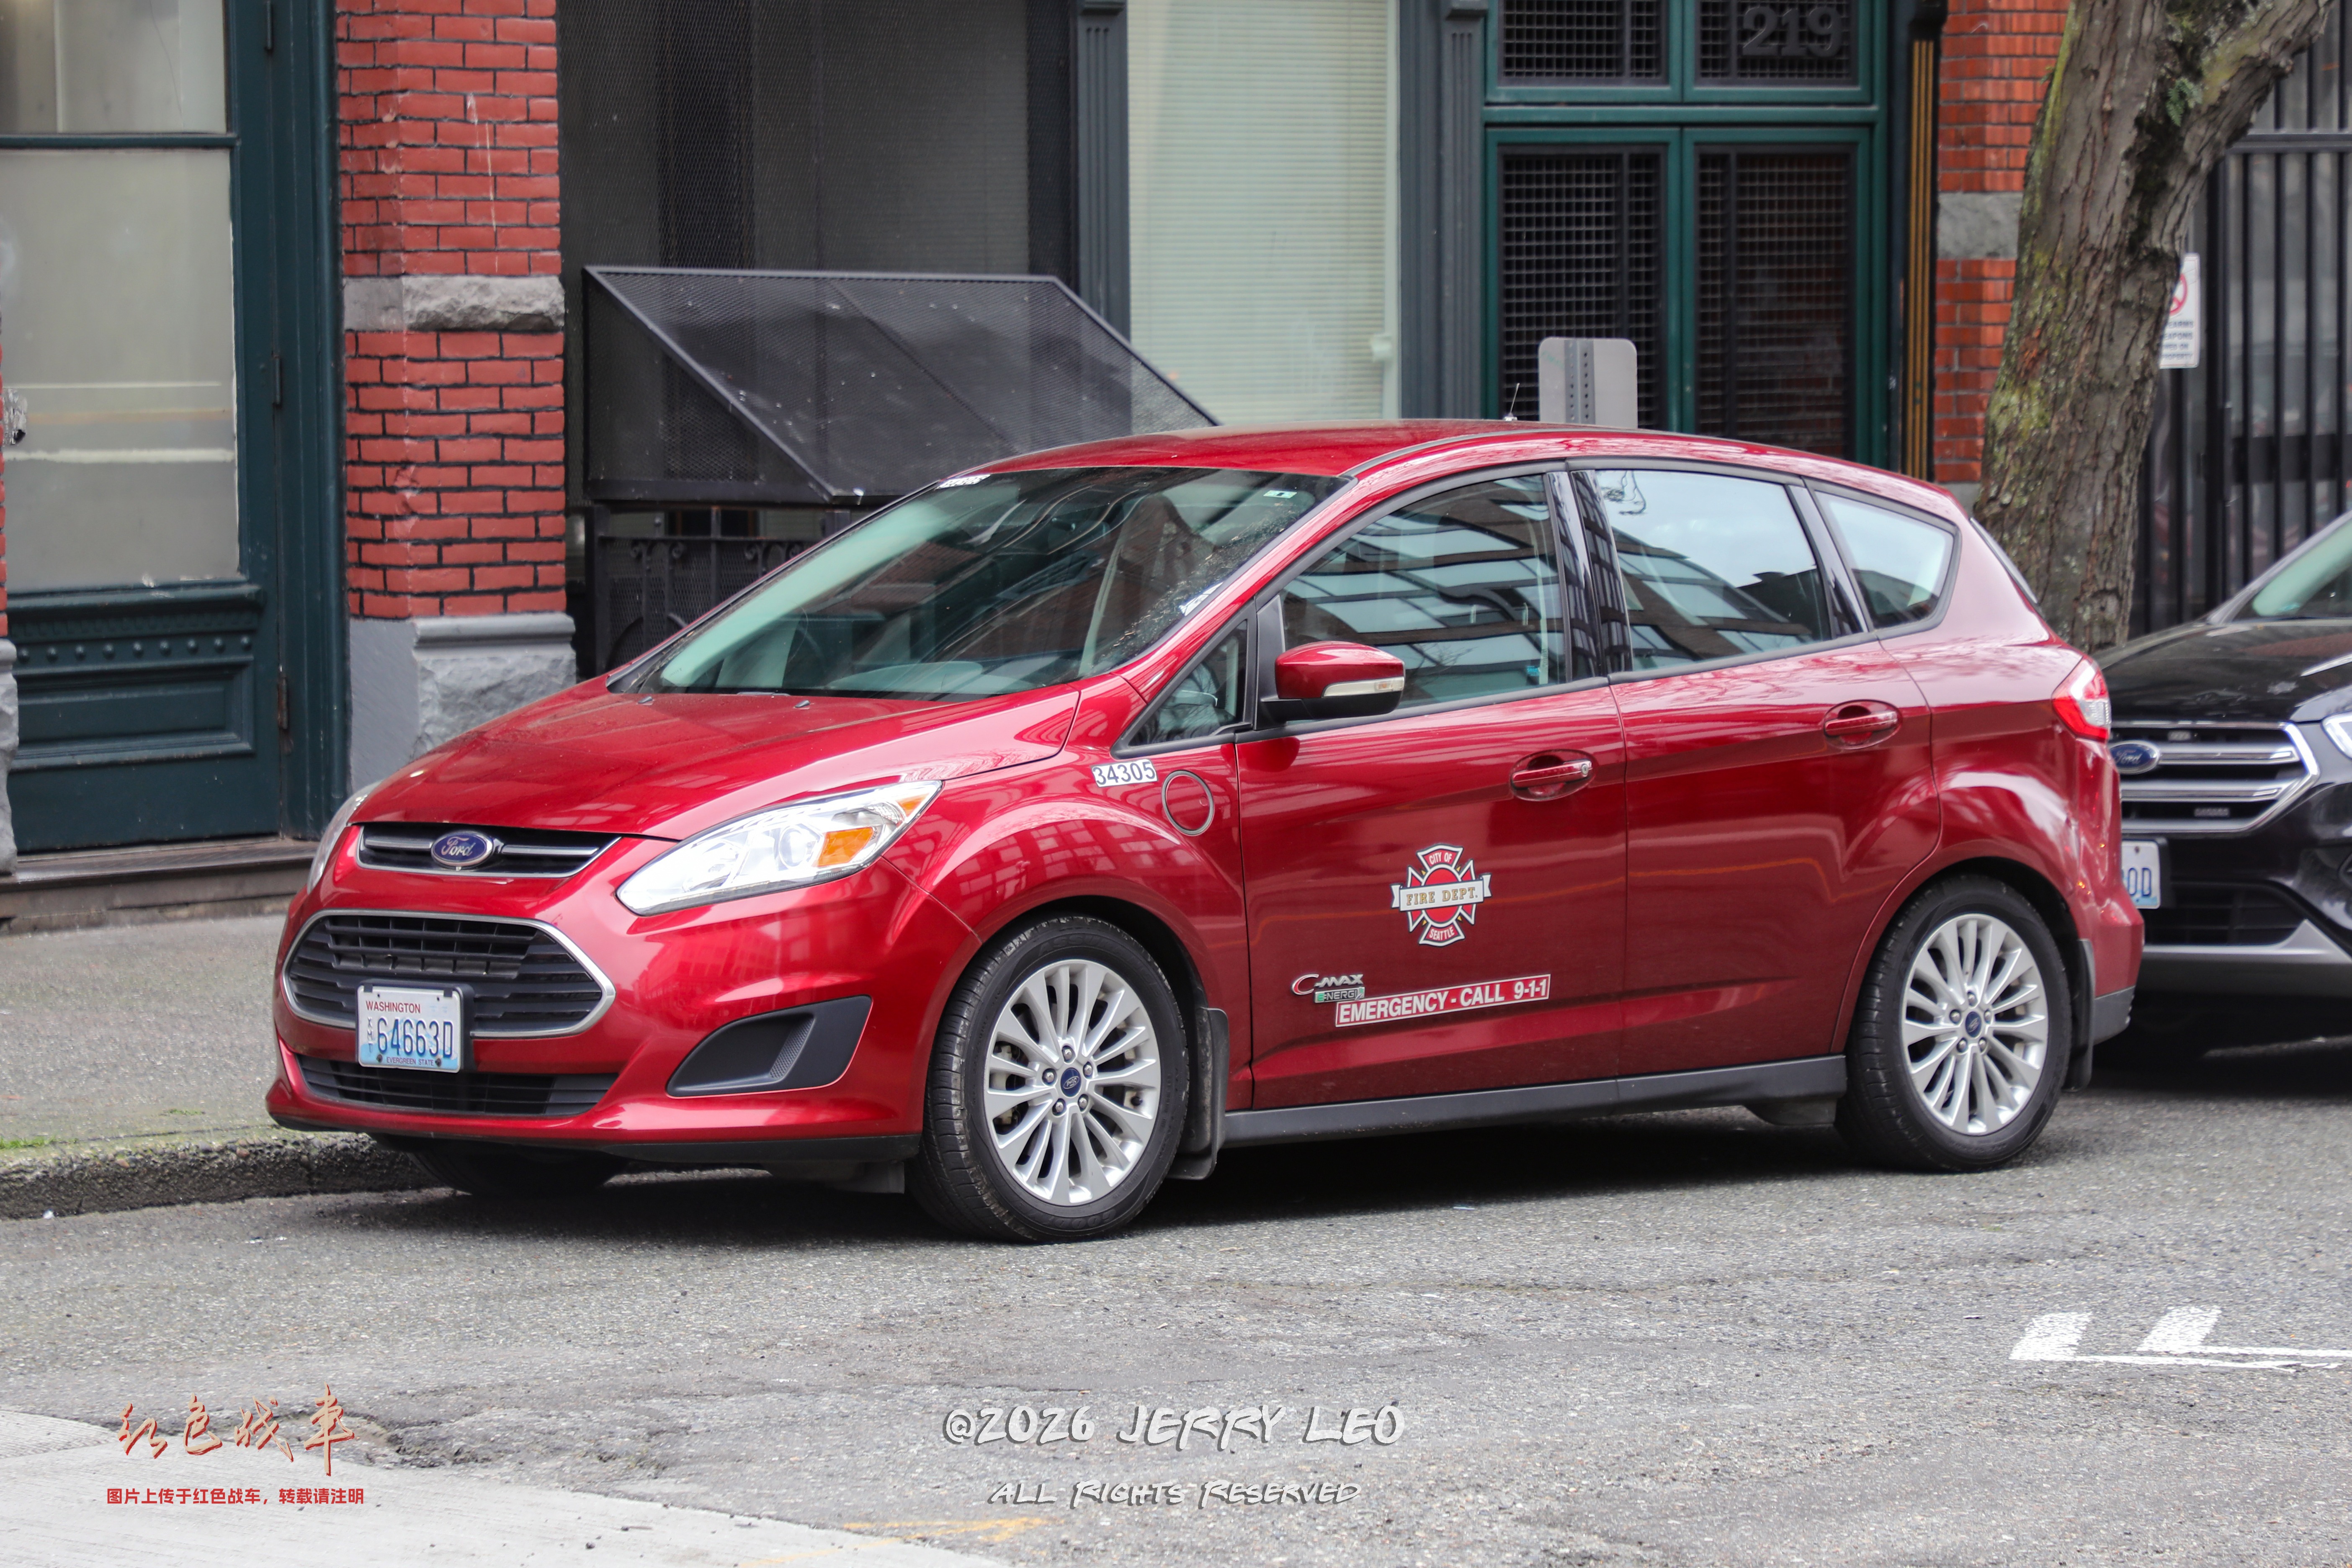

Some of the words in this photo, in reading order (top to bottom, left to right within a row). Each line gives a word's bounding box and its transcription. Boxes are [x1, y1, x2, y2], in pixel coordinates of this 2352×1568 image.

[1742, 6, 1842, 57] 219
[2115, 749, 2143, 765] Ford
[1093, 761, 1155, 785] 34305
[441, 836, 476, 856] Ford
[1429, 852, 1442, 865] CITY
[1444, 852, 1453, 863] OF
[2121, 867, 2151, 897] 0D
[1406, 891, 1435, 906] FIRE
[1442, 886, 1479, 902] DEPT.
[1429, 926, 1455, 941] SEATTLE
[1317, 990, 1358, 1002] ENERGI
[1339, 991, 1449, 1023] EMERGENCY
[1460, 984, 1505, 1007] CALL
[1514, 978, 1548, 1000] 9-1-1
[366, 1000, 421, 1014] WASHINGTON
[377, 1017, 453, 1059] 64663D
[386, 1057, 416, 1065] EVERGREEN
[419, 1058, 434, 1066] STATE
